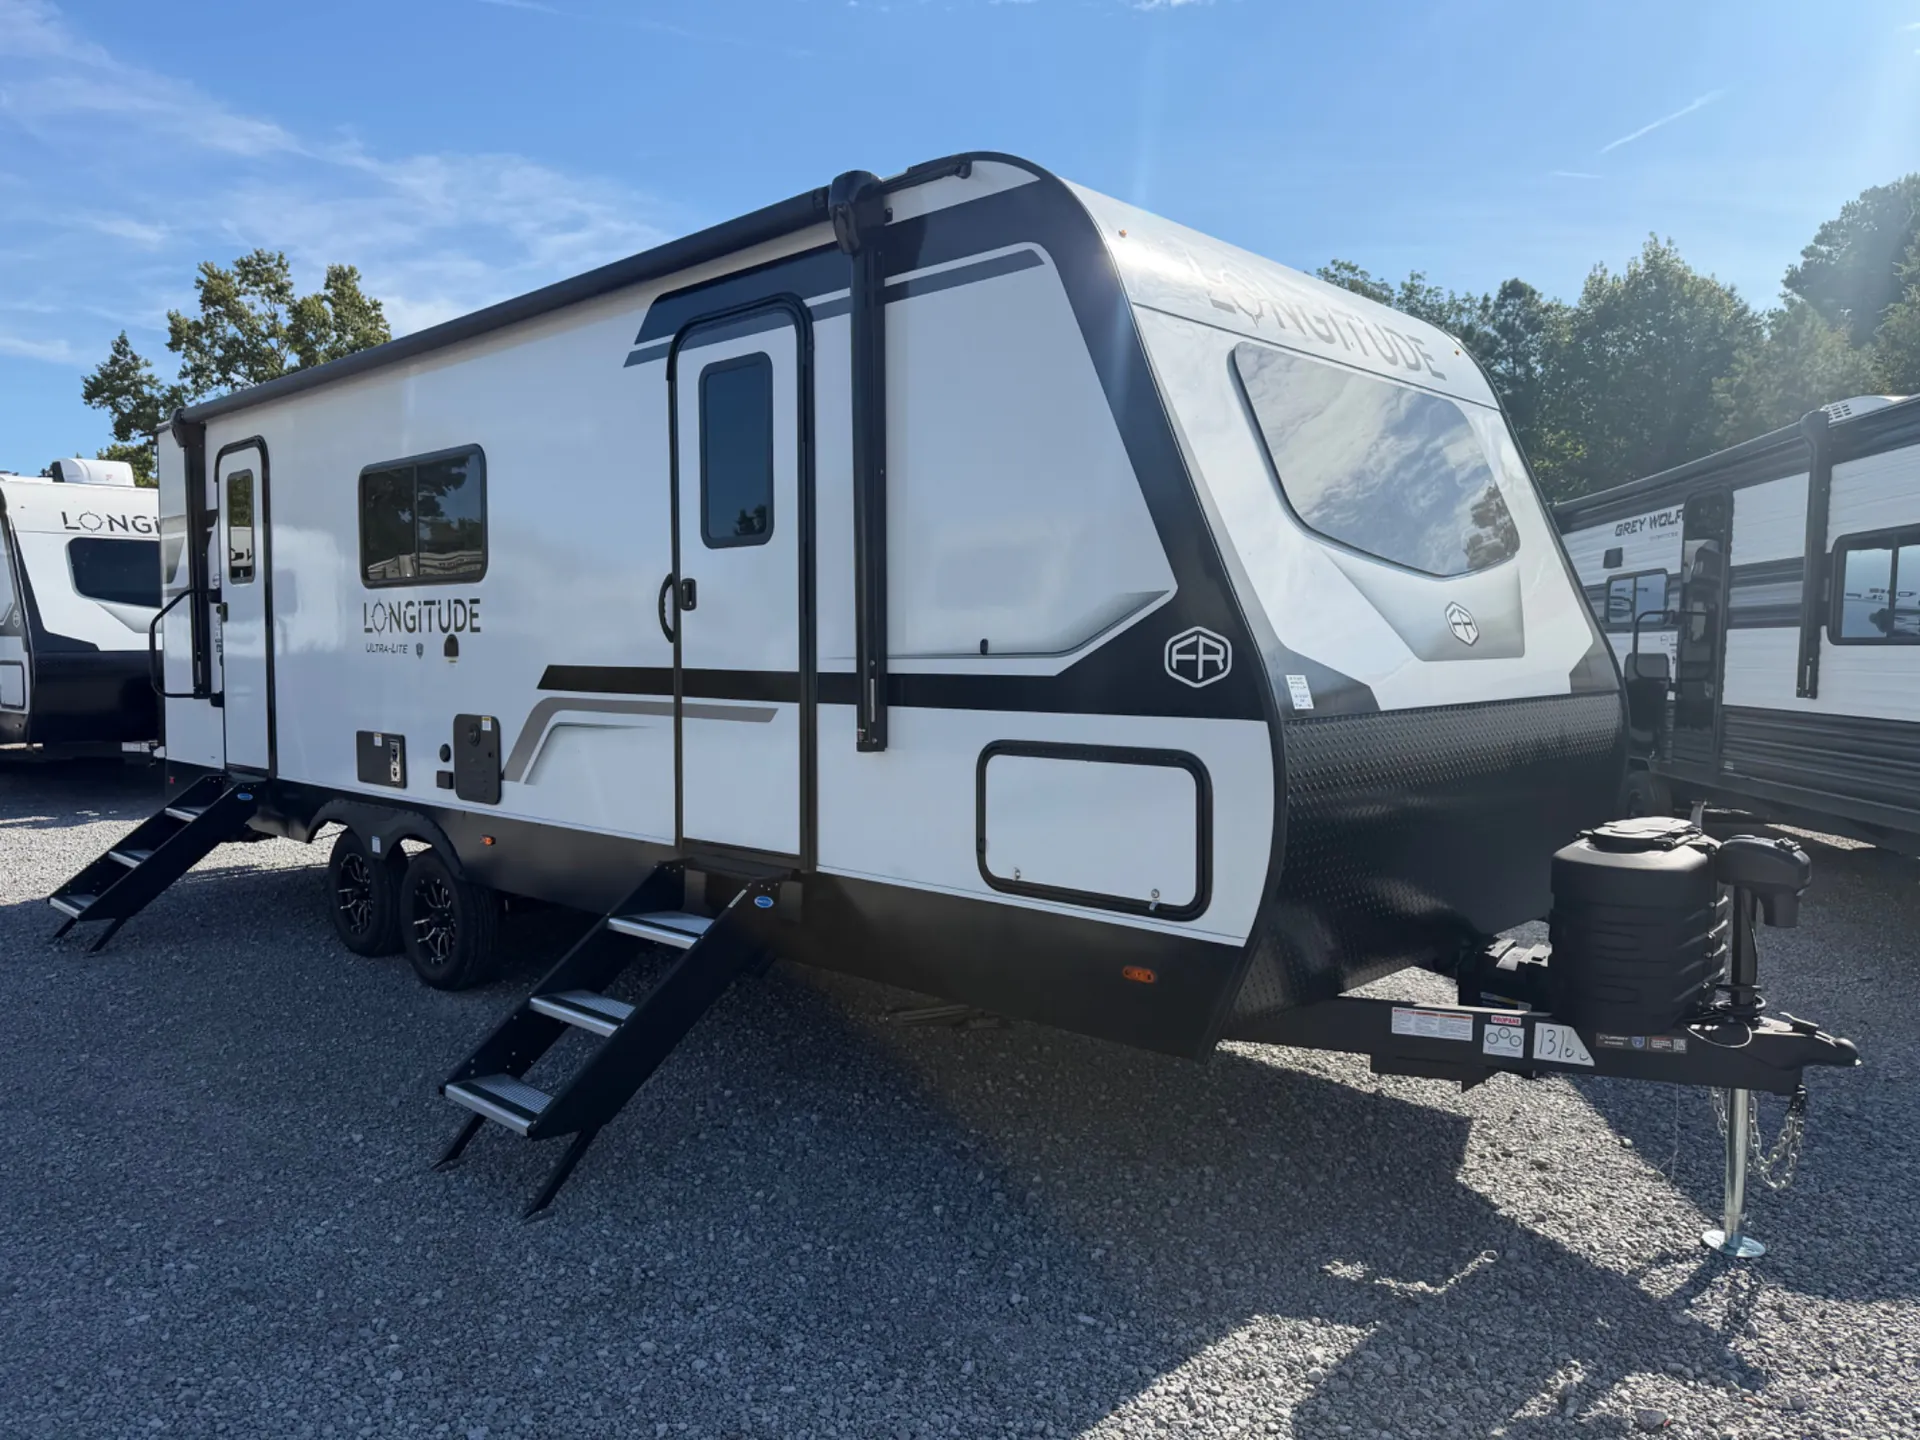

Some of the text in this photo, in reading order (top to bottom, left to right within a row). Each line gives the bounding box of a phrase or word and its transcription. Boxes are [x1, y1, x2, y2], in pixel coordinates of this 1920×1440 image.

[1614, 517, 1647, 537] GREY
[1648, 508, 1684, 530] WOLF
[363, 597, 481, 635] LONGITUDE
[1170, 633, 1226, 681] FR
